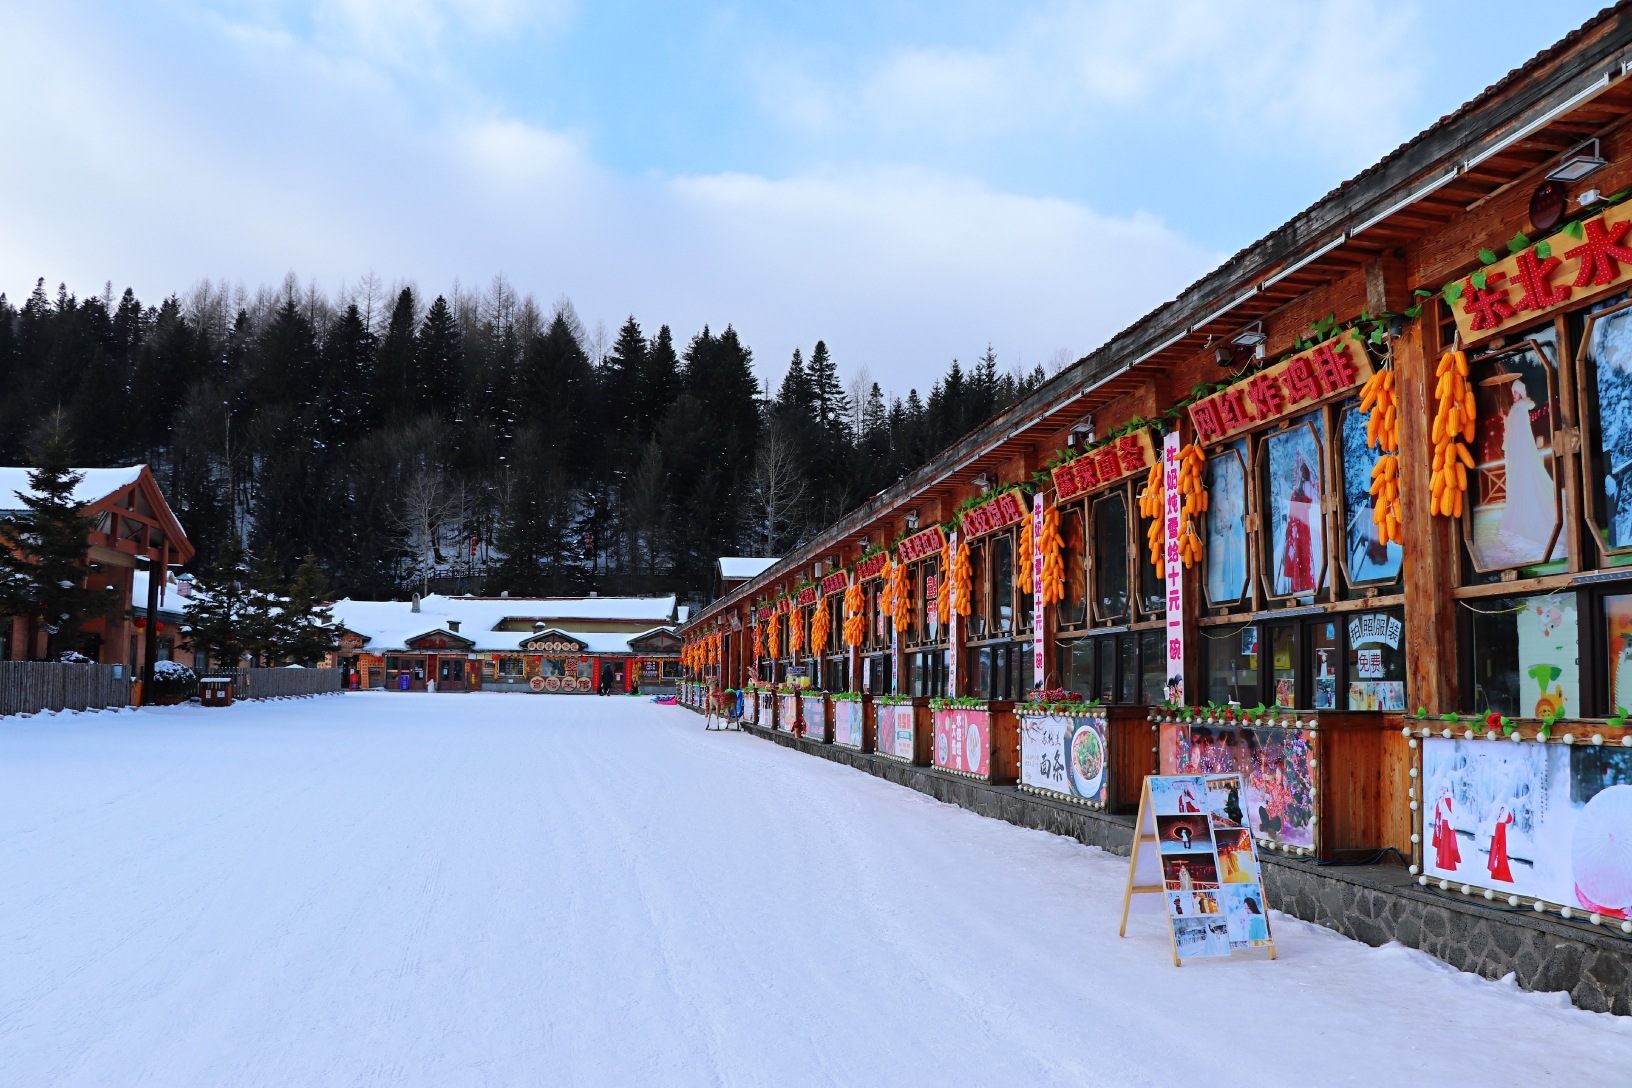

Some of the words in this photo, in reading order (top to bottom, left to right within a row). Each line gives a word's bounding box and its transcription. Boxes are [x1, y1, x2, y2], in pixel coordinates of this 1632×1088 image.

[1190, 339, 1359, 443] 网红炸鸡排
[1053, 434, 1146, 500] 麻辣面条
[963, 493, 1022, 537] 水饺馄饨
[1166, 445, 1181, 661] 牛奶炖雪蛤十元一碗
[1350, 619, 1400, 643] 拍照服装
[1358, 653, 1381, 673] 免费
